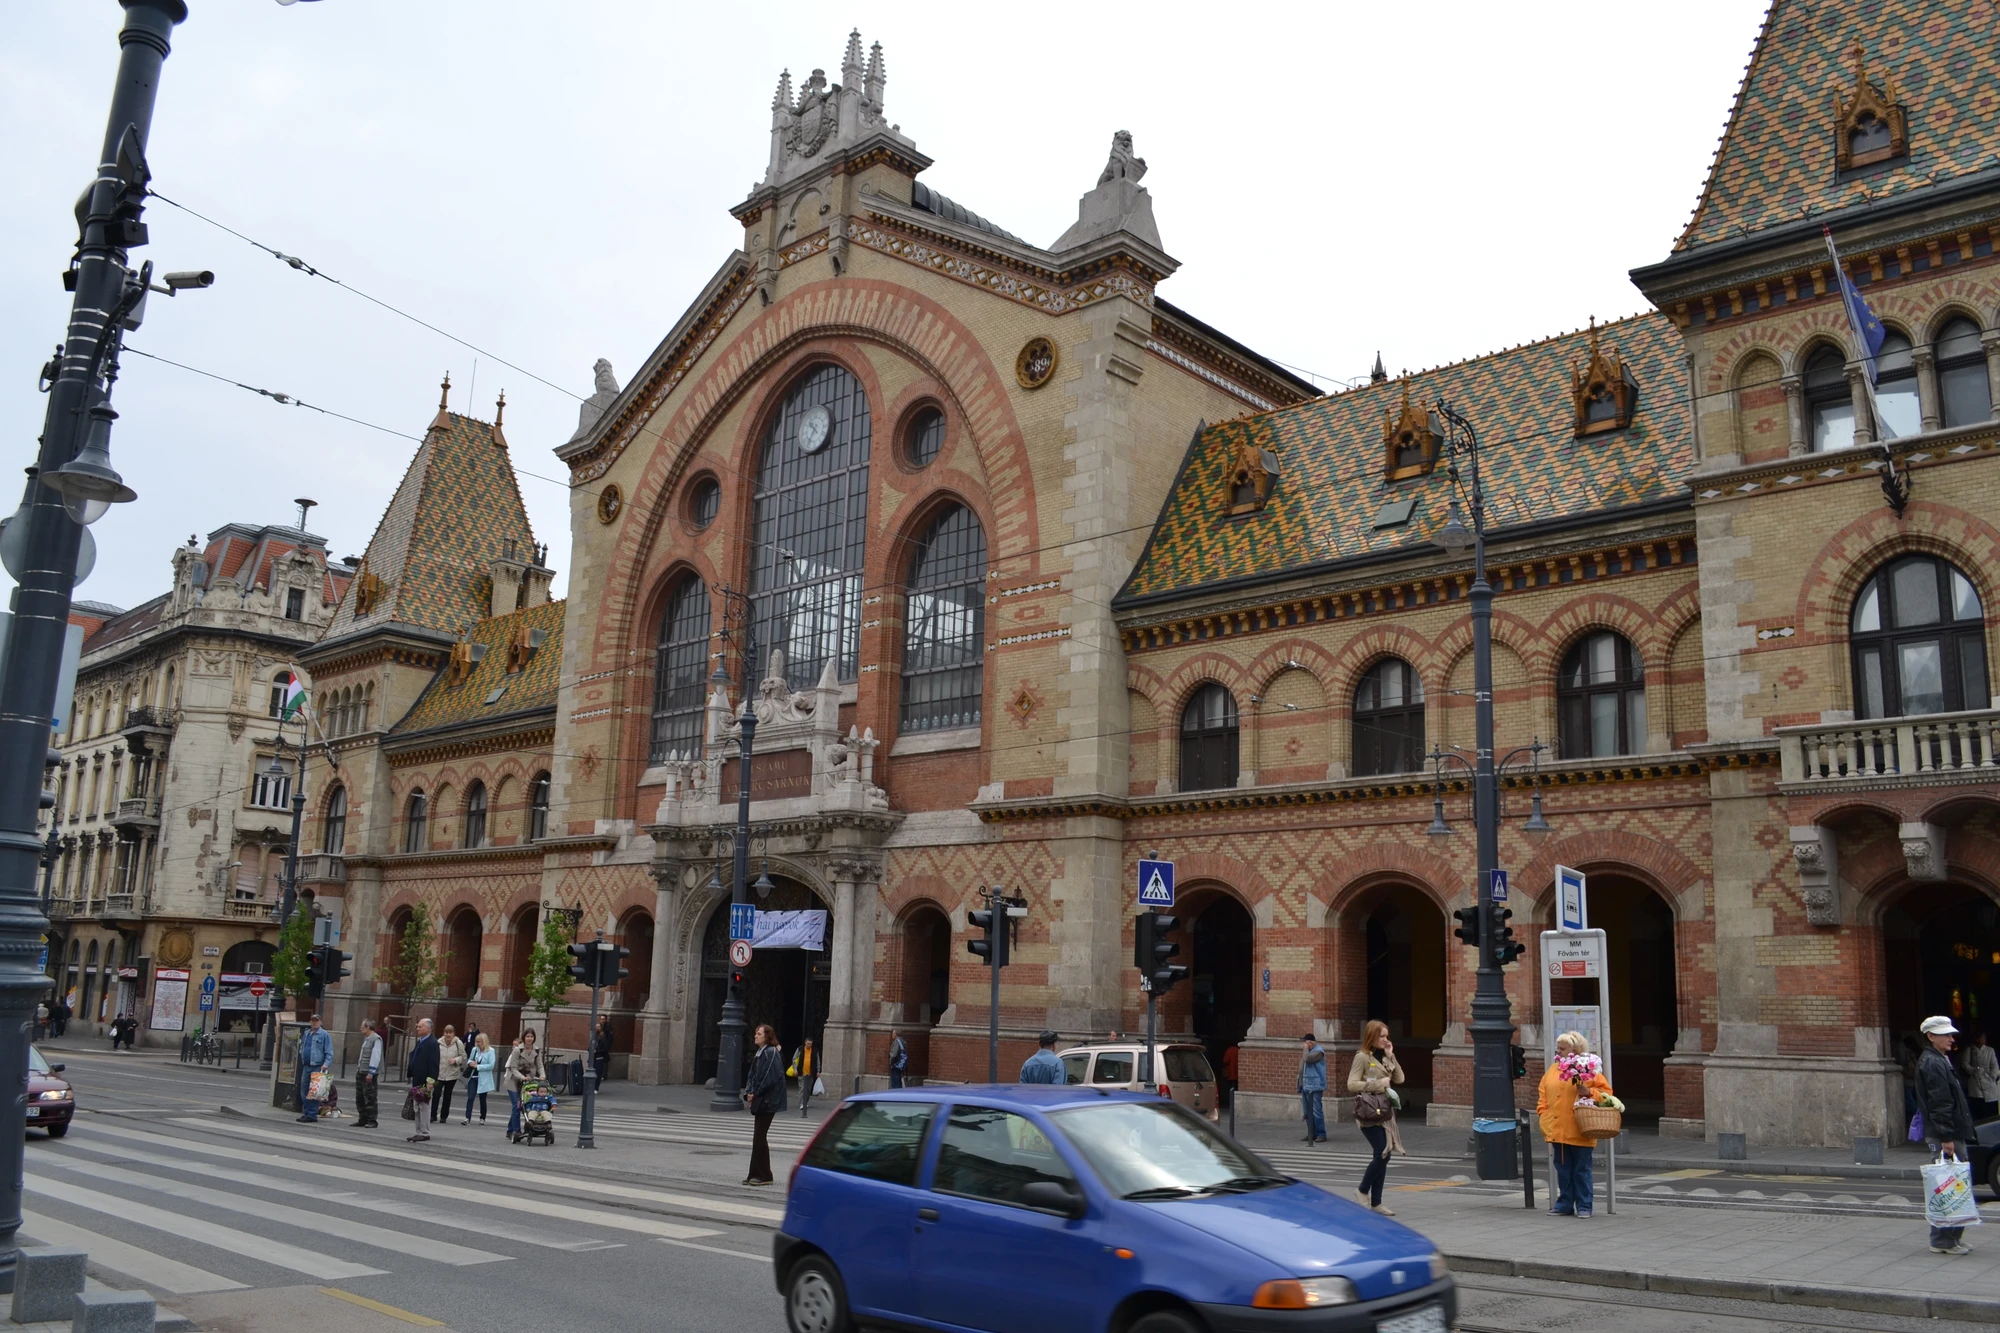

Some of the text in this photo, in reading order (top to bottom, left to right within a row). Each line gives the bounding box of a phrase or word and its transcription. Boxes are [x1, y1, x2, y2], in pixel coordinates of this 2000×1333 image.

[1570, 940, 1582, 948] MM
[1557, 949, 1590, 957] Fővám tér
